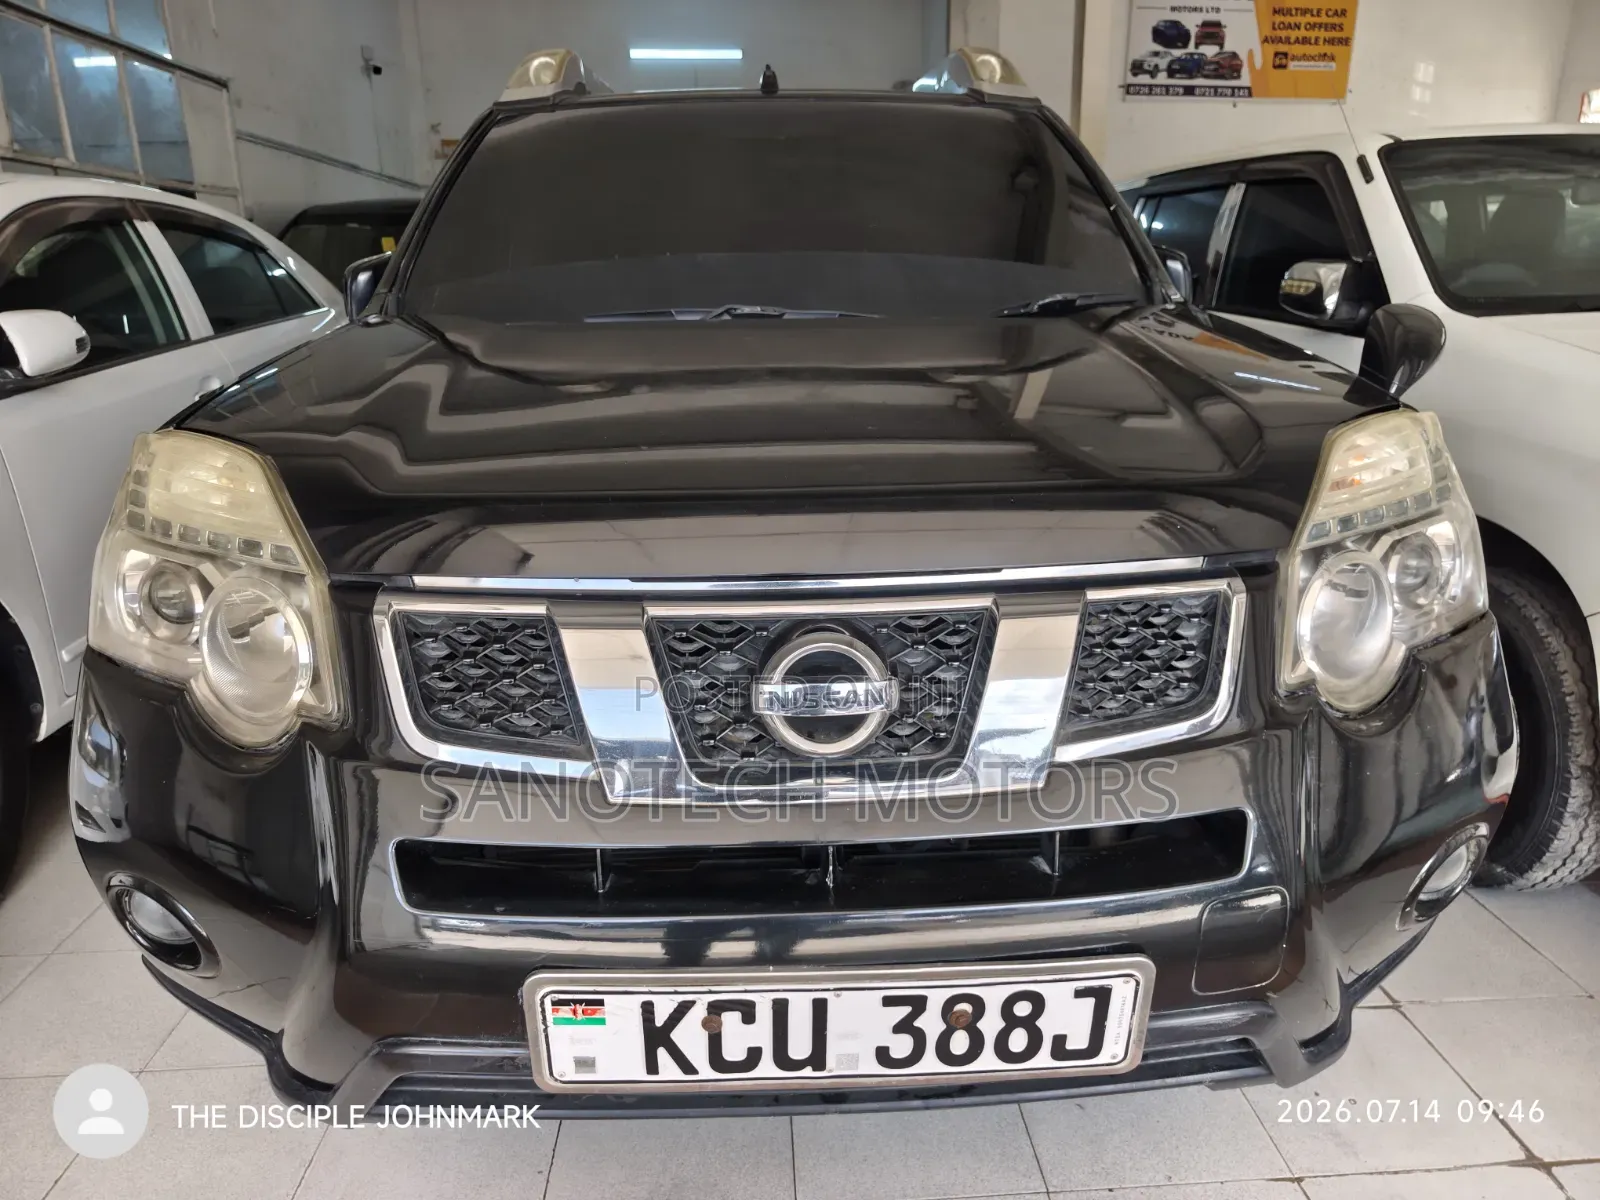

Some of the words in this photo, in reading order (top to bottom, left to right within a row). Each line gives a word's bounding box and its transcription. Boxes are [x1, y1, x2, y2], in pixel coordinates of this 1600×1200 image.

[1170, 5, 1203, 13] MOTORS
[1272, 7, 1322, 17] MULTIPLE
[1325, 8, 1347, 18] CAR
[1272, 21, 1300, 31] LOAN
[1304, 22, 1344, 32] OFFERS
[1262, 35, 1320, 46] AVAILABLE
[1323, 36, 1351, 46] HERE
[765, 690, 887, 712] NISSAN
[641, 998, 828, 1075] KCU
[875, 984, 1113, 1070] 388J
